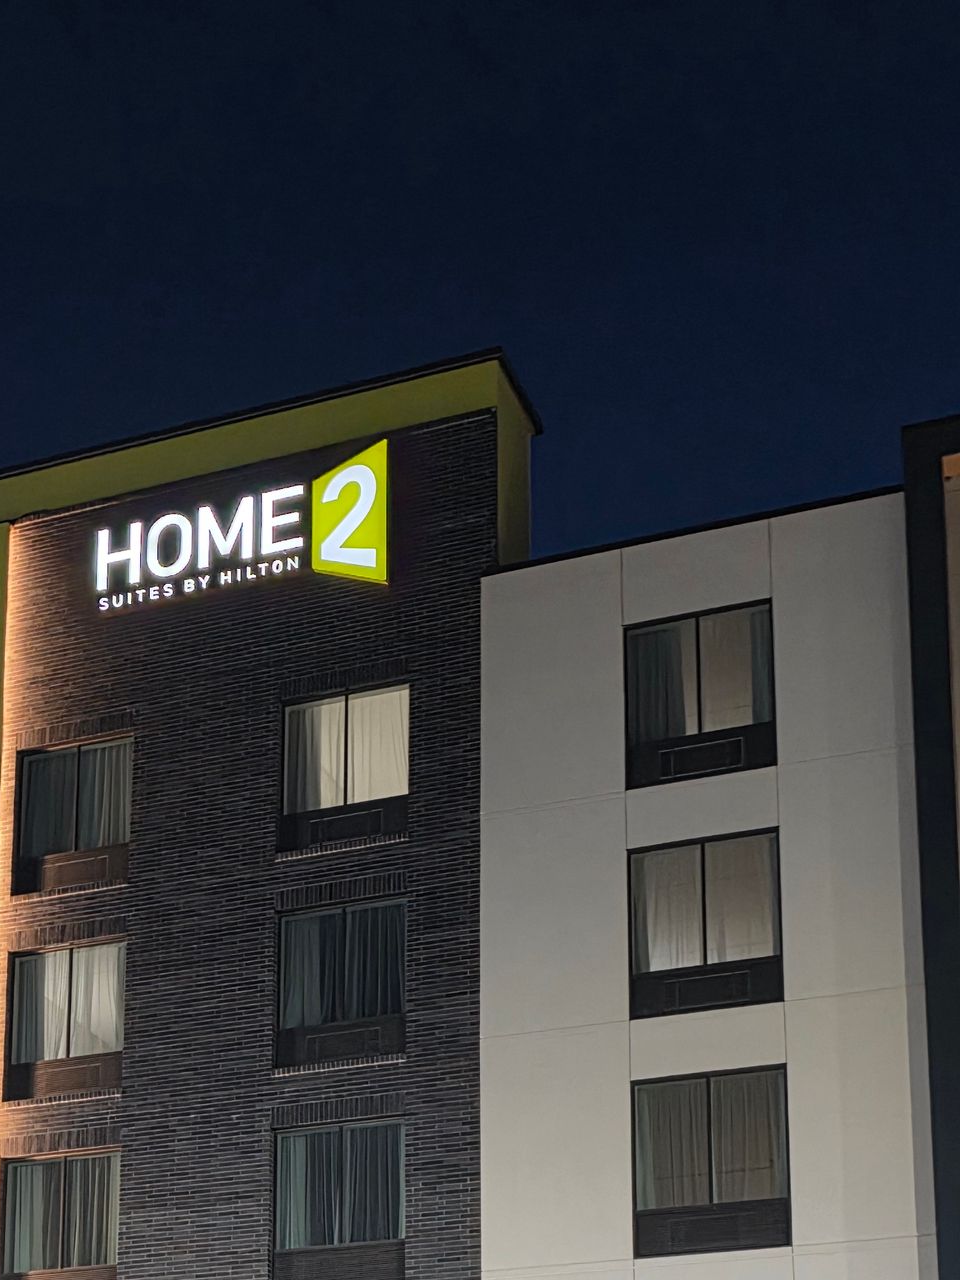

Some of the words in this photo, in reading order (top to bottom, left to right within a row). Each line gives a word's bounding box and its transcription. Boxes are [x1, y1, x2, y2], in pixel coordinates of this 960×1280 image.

[96, 484, 305, 591] HOME
[321, 464, 377, 568] 2
[98, 583, 174, 611] SUITES
[183, 574, 211, 593] BY
[220, 556, 300, 585] HILTON
